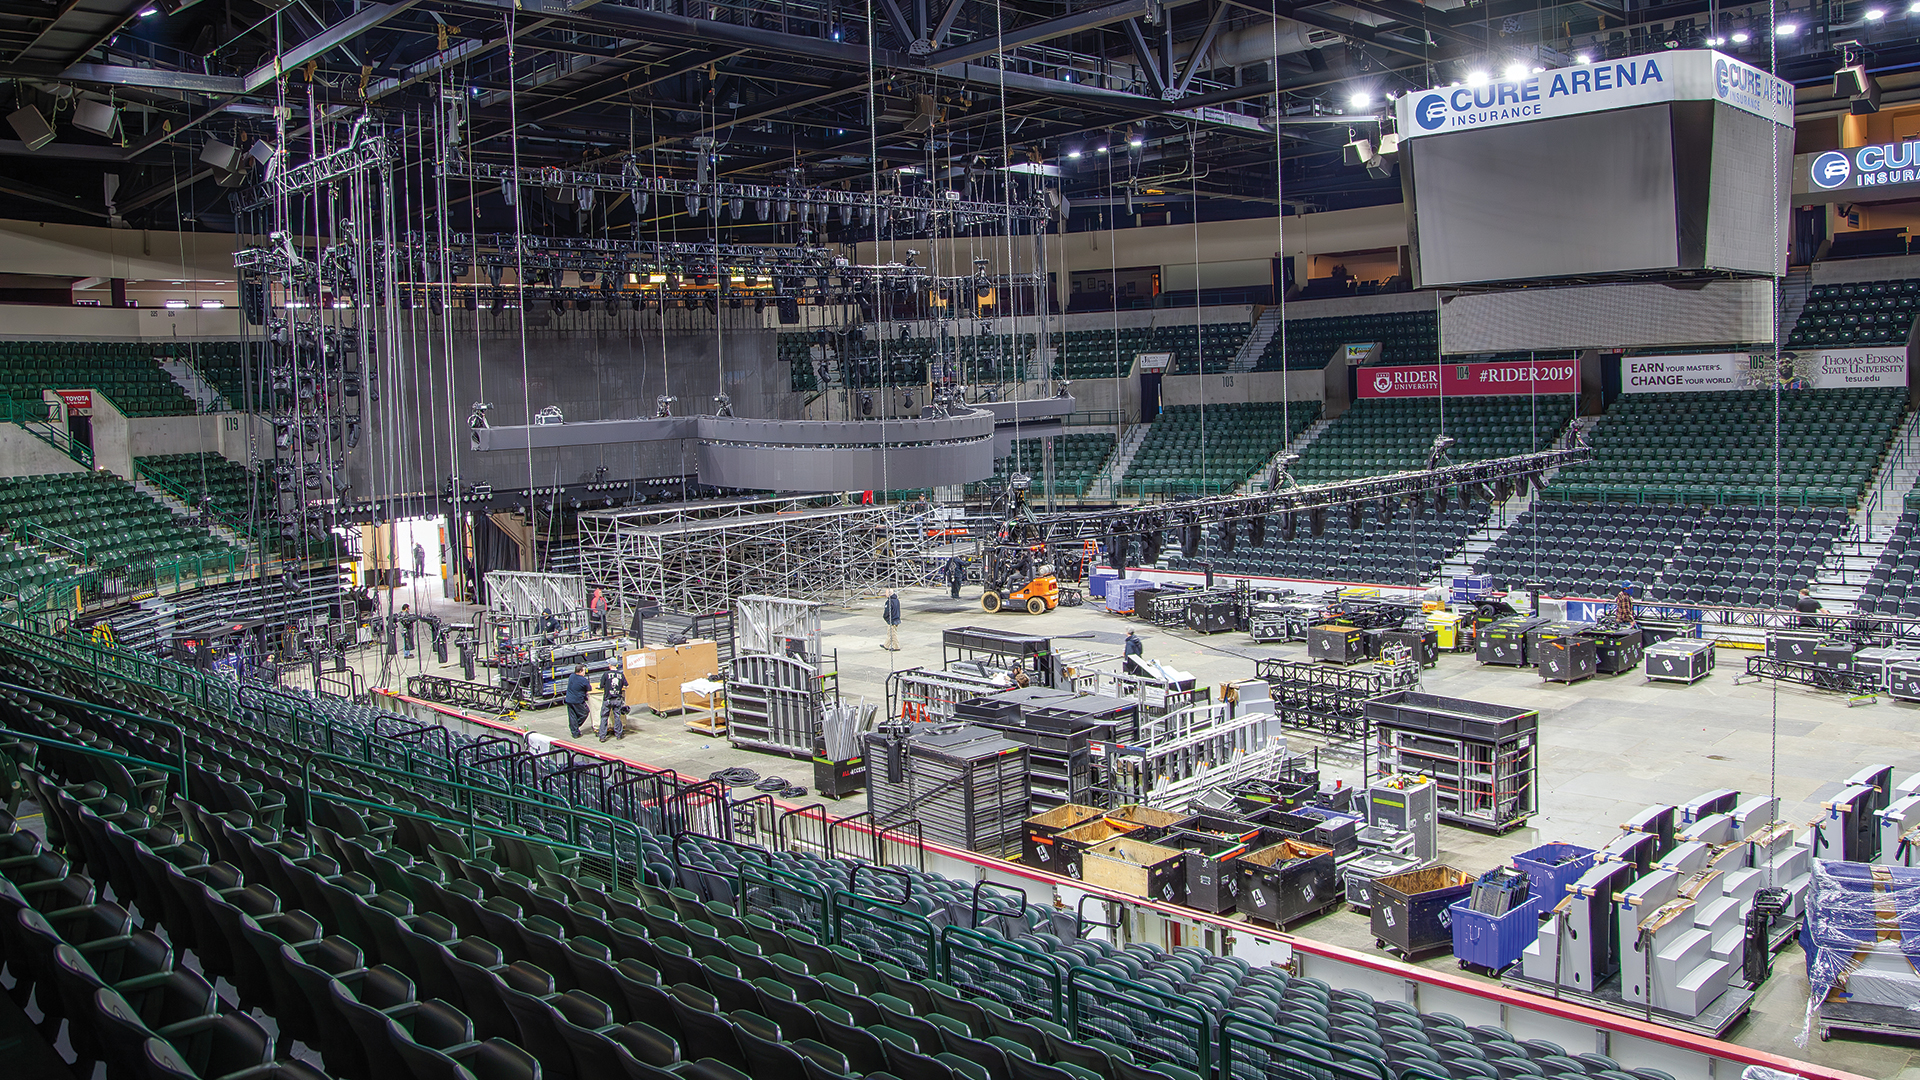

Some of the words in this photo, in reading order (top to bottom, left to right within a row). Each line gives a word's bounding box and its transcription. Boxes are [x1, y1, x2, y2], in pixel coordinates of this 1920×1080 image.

[1450, 76, 1540, 112] CURE
[1548, 58, 1664, 98] ARENA
[1729, 63, 1761, 97] CURE
[1729, 90, 1760, 111] INSURANCE
[1451, 104, 1542, 127] INSURANCE
[1856, 141, 1920, 171] CU
[1749, 355, 1764, 369] 105
[1821, 355, 1863, 365] THOMAS
[1866, 353, 1904, 364] EDISON
[1456, 366, 1469, 380] 104
[1479, 367, 1573, 382] #RIDER2019
[1631, 363, 1664, 373] EARN
[1821, 365, 1847, 374] STATE
[1849, 364, 1904, 374] UNIVERSITY
[1222, 376, 1234, 388] 103
[1394, 371, 1438, 383] RIDER
[1631, 375, 1683, 386] CHANGE
[1394, 382, 1438, 390] UNIVERSITY
[225, 417, 239, 431] 119
[850, 766, 866, 775] ACCESS
